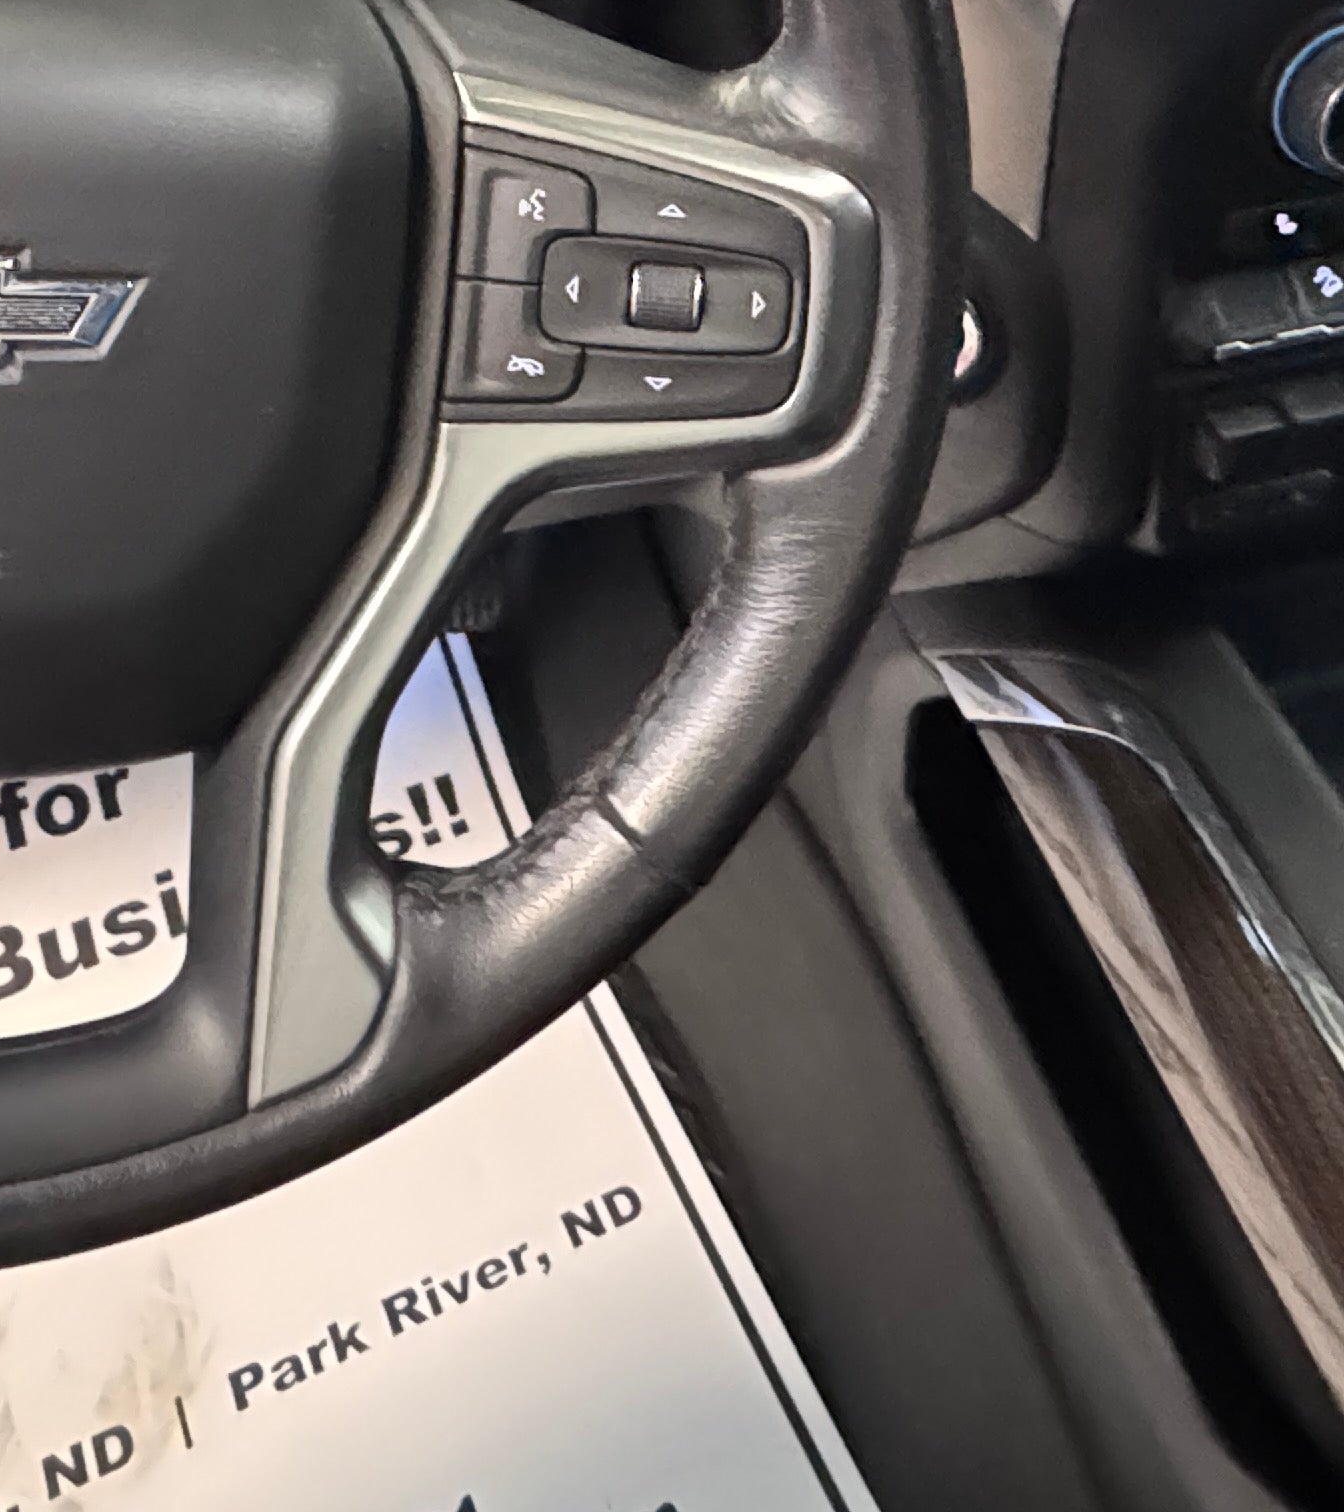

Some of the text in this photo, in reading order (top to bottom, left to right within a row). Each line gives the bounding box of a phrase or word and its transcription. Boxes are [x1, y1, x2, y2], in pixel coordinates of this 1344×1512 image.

[41, 1424, 135, 1502] ND
[227, 1320, 372, 1413] Park
[380, 1241, 552, 1338] River,
[559, 1185, 644, 1250] ND
